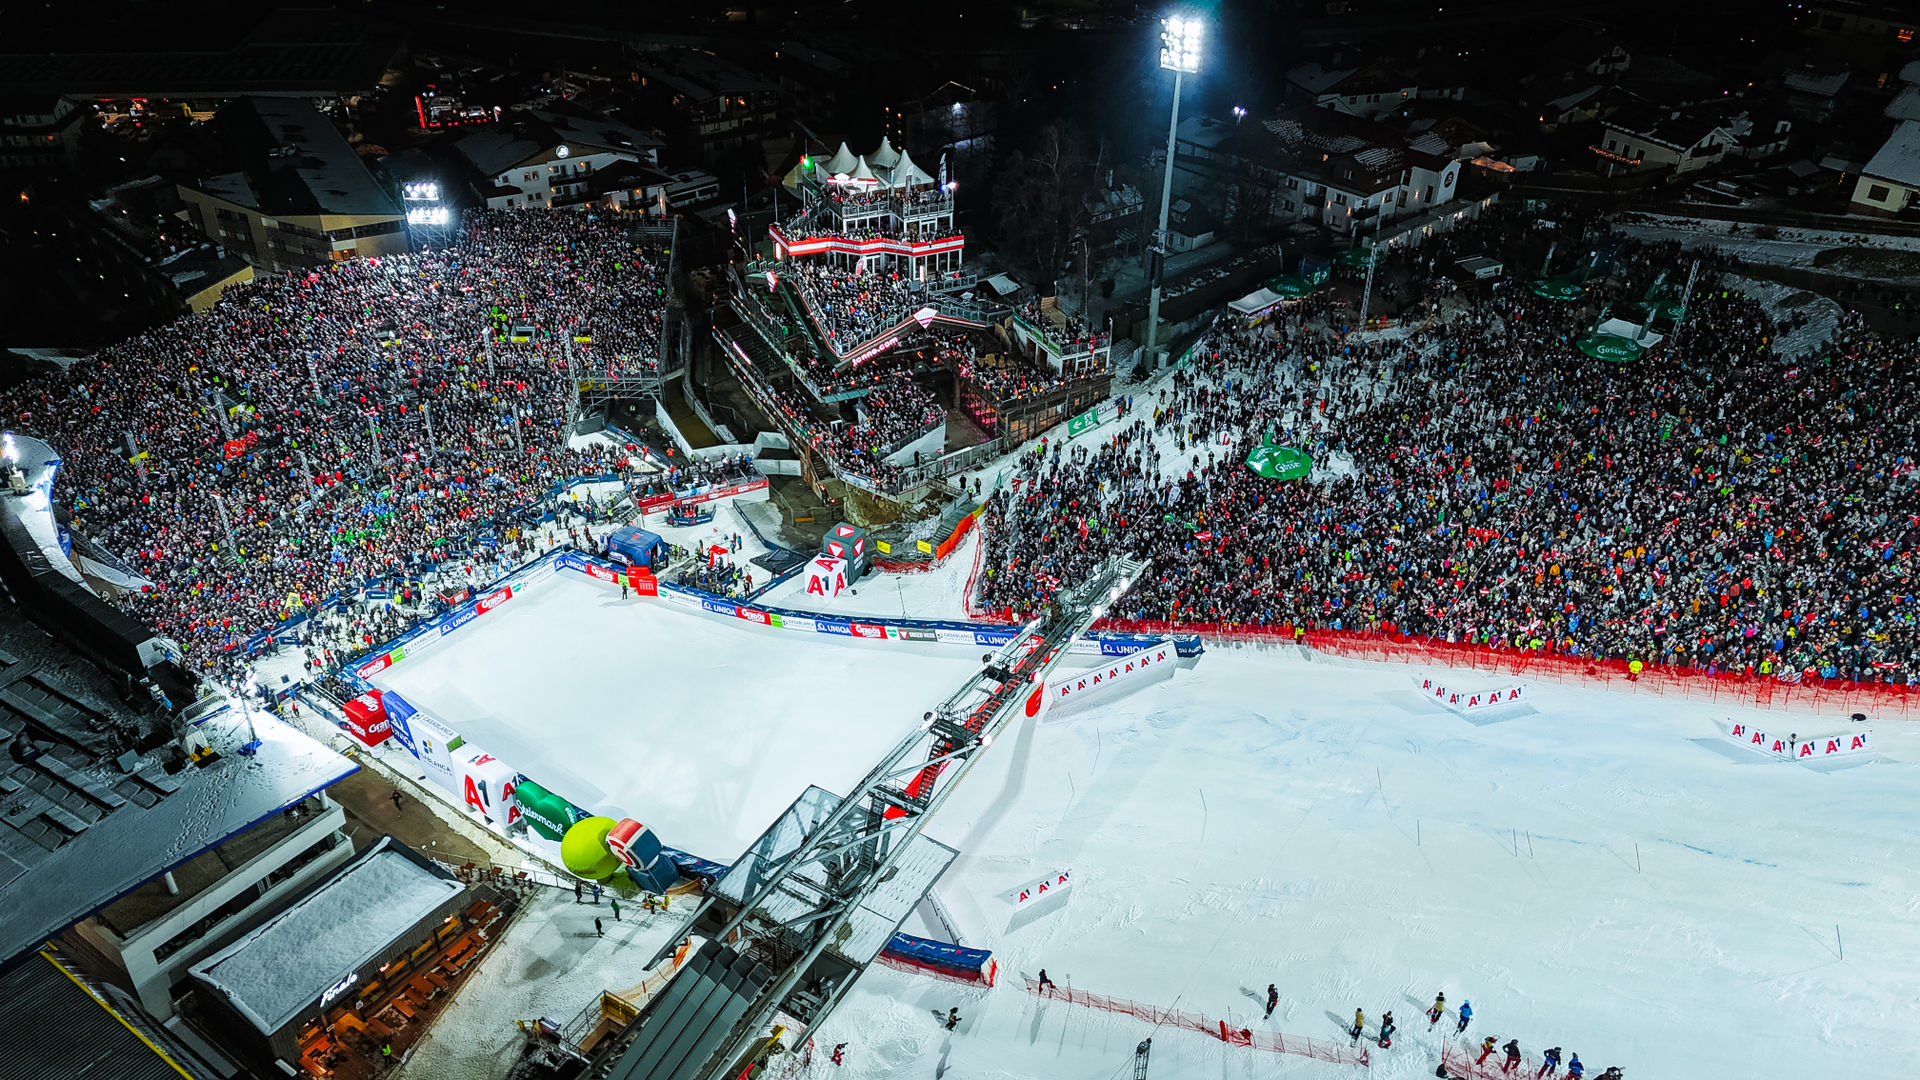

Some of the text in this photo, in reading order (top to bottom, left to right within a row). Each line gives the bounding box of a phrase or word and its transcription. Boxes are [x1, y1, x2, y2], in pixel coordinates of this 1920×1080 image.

[807, 574, 829, 596] A1
[452, 610, 476, 627] UNIQA
[713, 605, 736, 616] UNIQA
[828, 625, 852, 634] UNIQA
[1061, 650, 1166, 696] A1 A1 A1 A1 A1 A1 A1
[1422, 679, 1460, 704] A1 A1 A1
[1468, 687, 1522, 707] A1 A1 A1
[1732, 724, 1786, 753] A1 A1 A1
[1800, 734, 1866, 757] A1 A1 A1
[465, 774, 490, 814] A1
[516, 799, 566, 836] Steiermark
[1019, 872, 1069, 903] A1 A1 A1
[320, 972, 358, 1008] Finale
